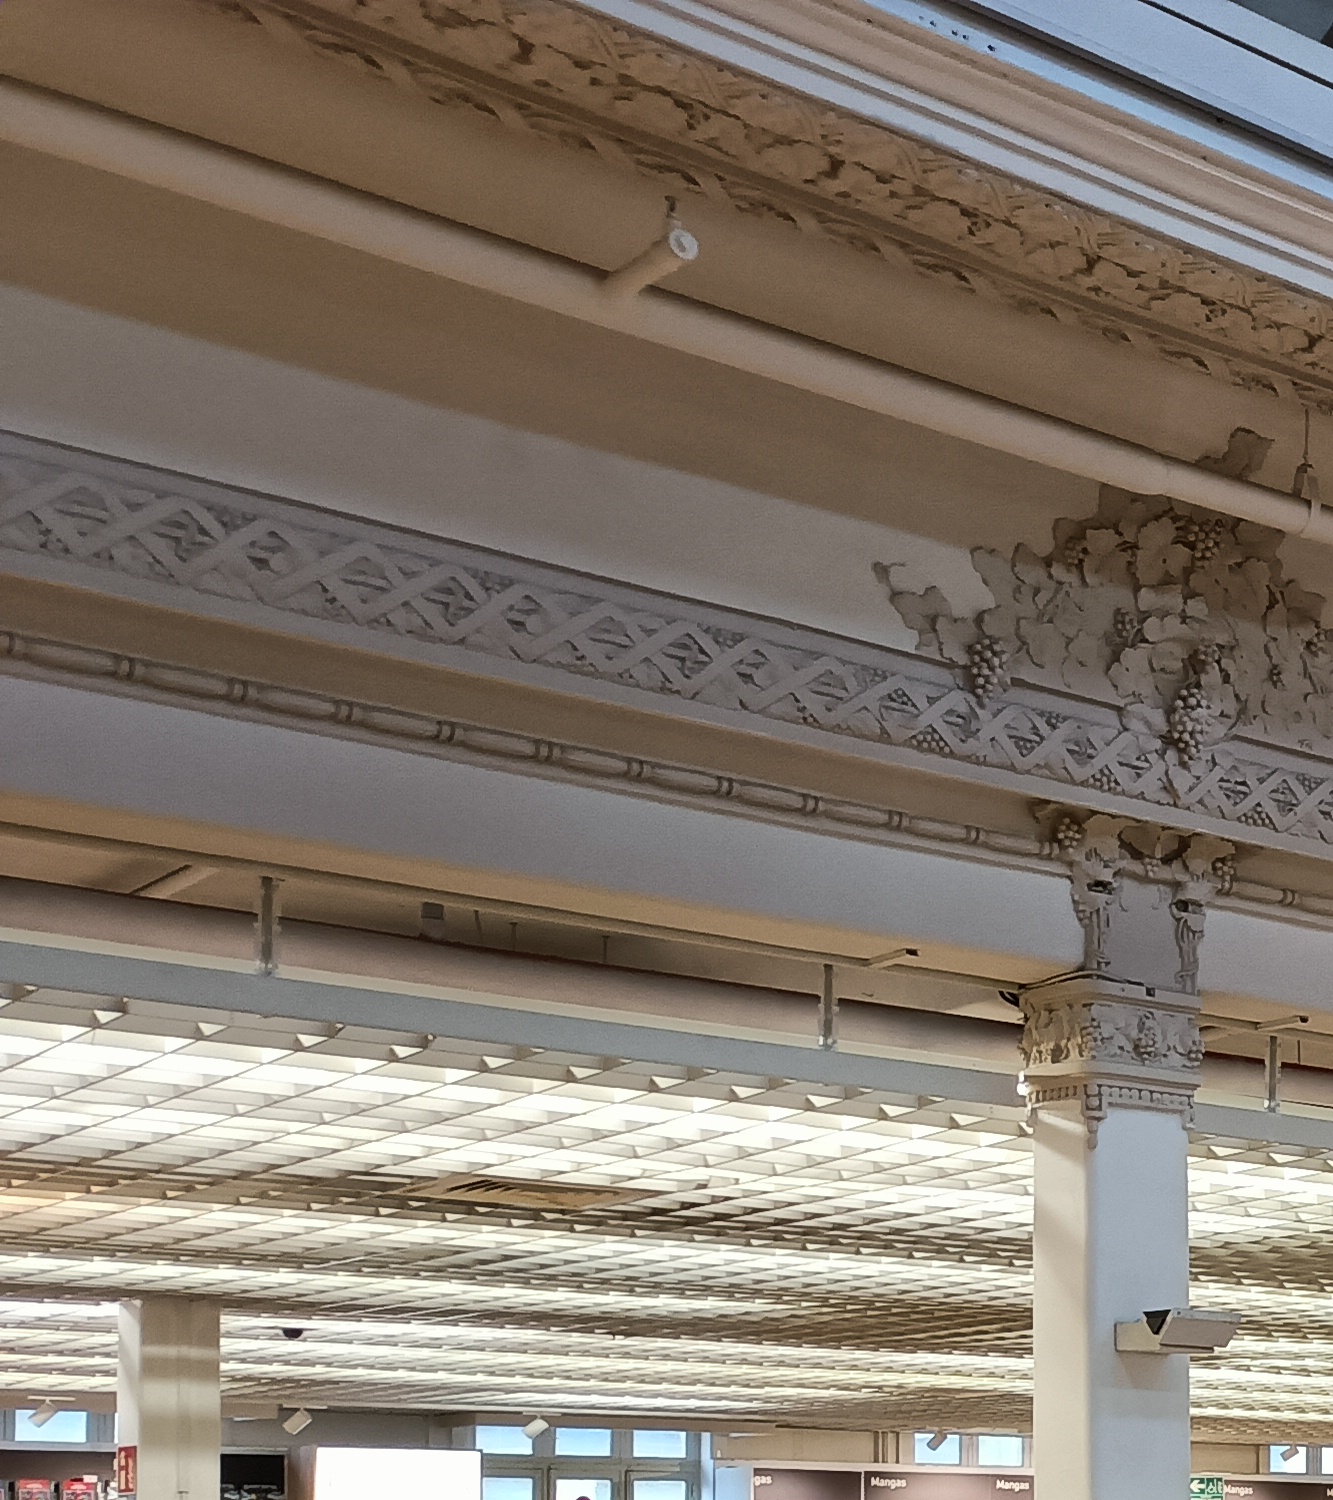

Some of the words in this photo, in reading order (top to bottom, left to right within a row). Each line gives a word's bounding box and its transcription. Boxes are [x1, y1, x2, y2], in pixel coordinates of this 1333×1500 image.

[871, 1476, 907, 1489] Mangas
[996, 1479, 1030, 1492] Mangas
[1223, 1484, 1254, 1497] Mangas
